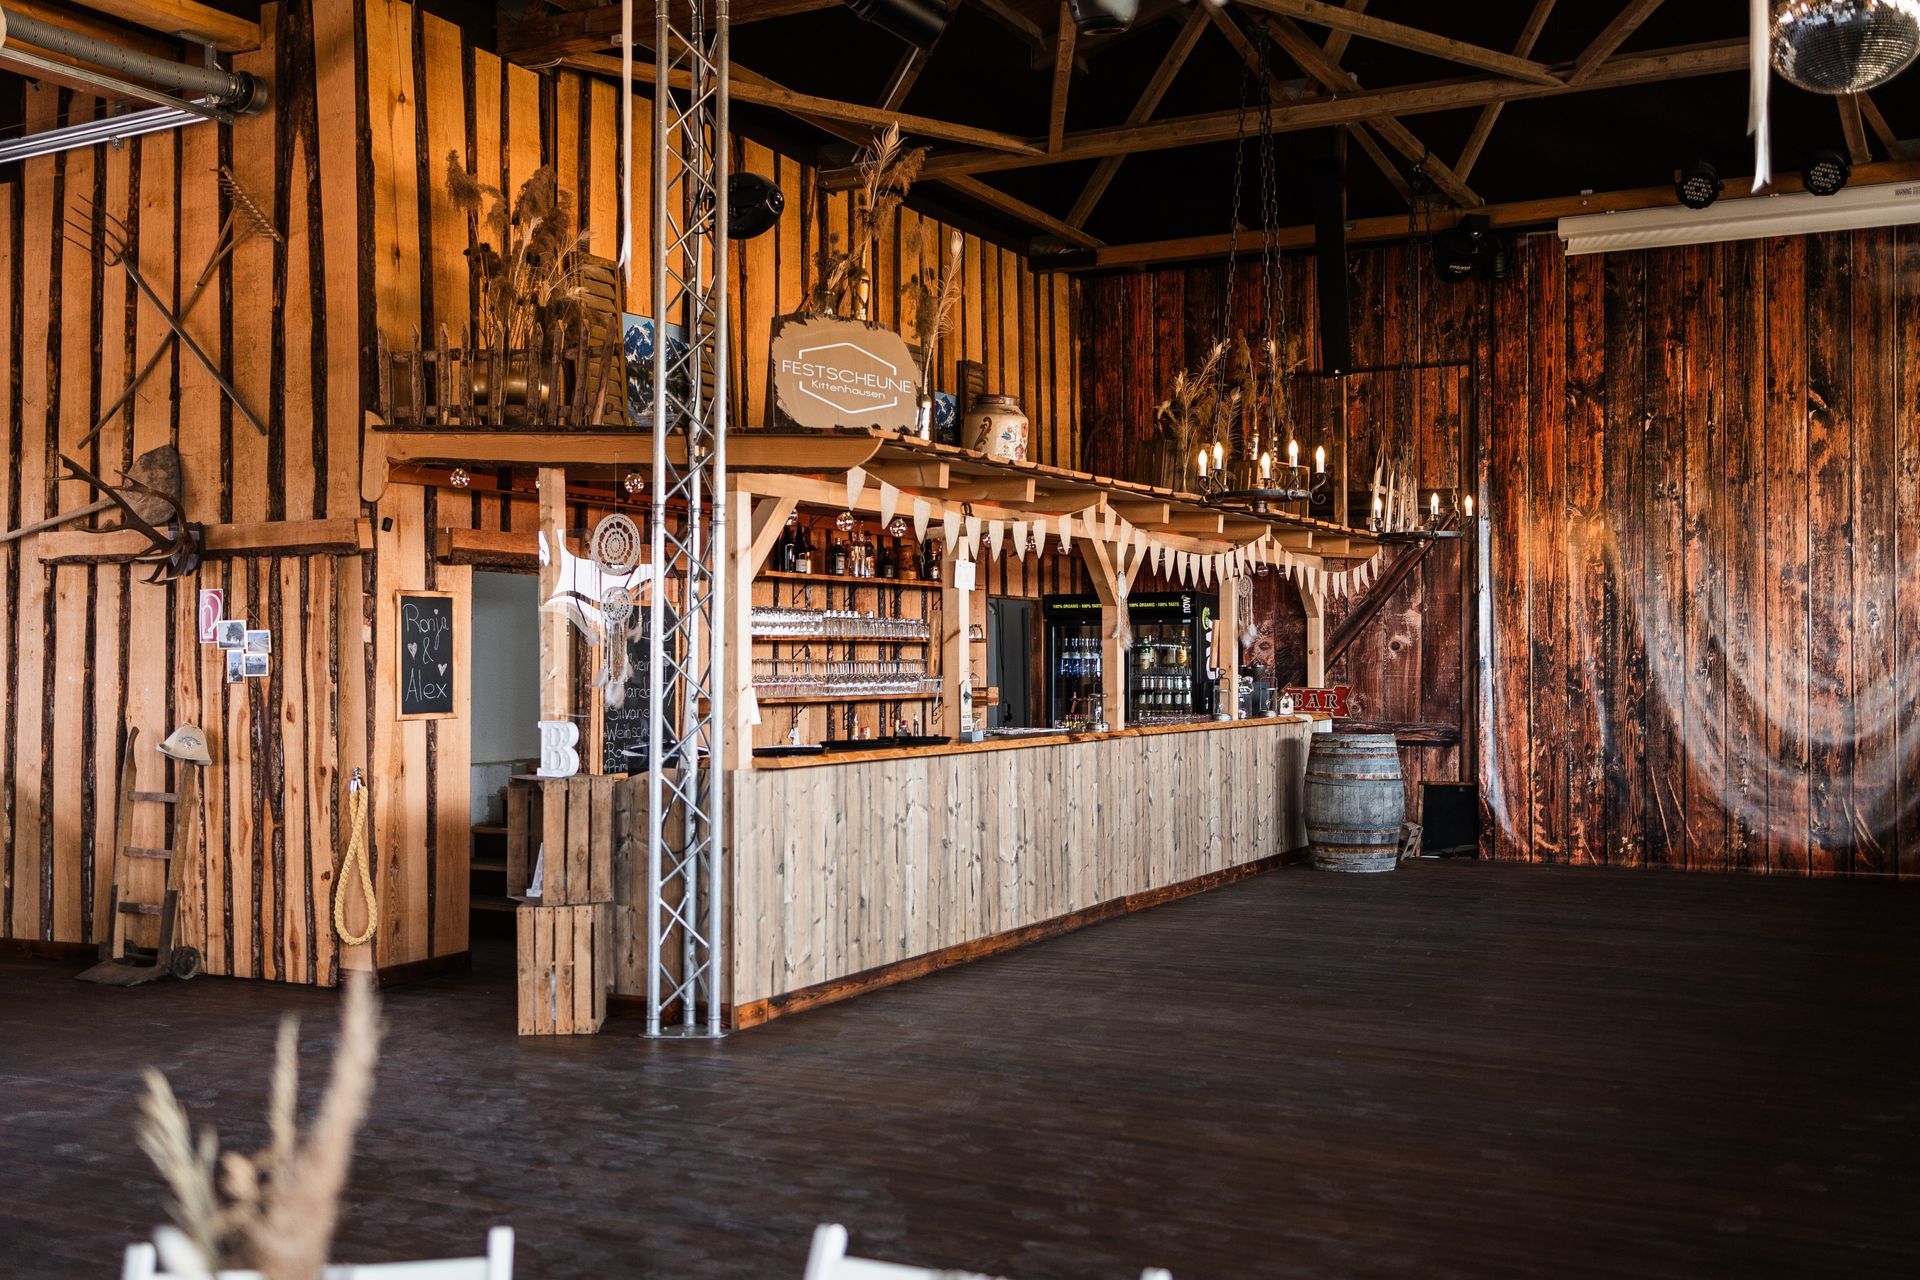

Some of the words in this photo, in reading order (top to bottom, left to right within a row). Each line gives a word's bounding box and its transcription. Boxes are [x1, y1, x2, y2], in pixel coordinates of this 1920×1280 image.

[782, 359, 912, 394] FESTSCHEUNE
[811, 378, 886, 400] Kittenhausen
[402, 603, 449, 650] Ronja
[422, 637, 434, 664] &
[405, 667, 447, 702] Alex
[608, 706, 650, 720] Silvane
[1291, 693, 1340, 709] BAR
